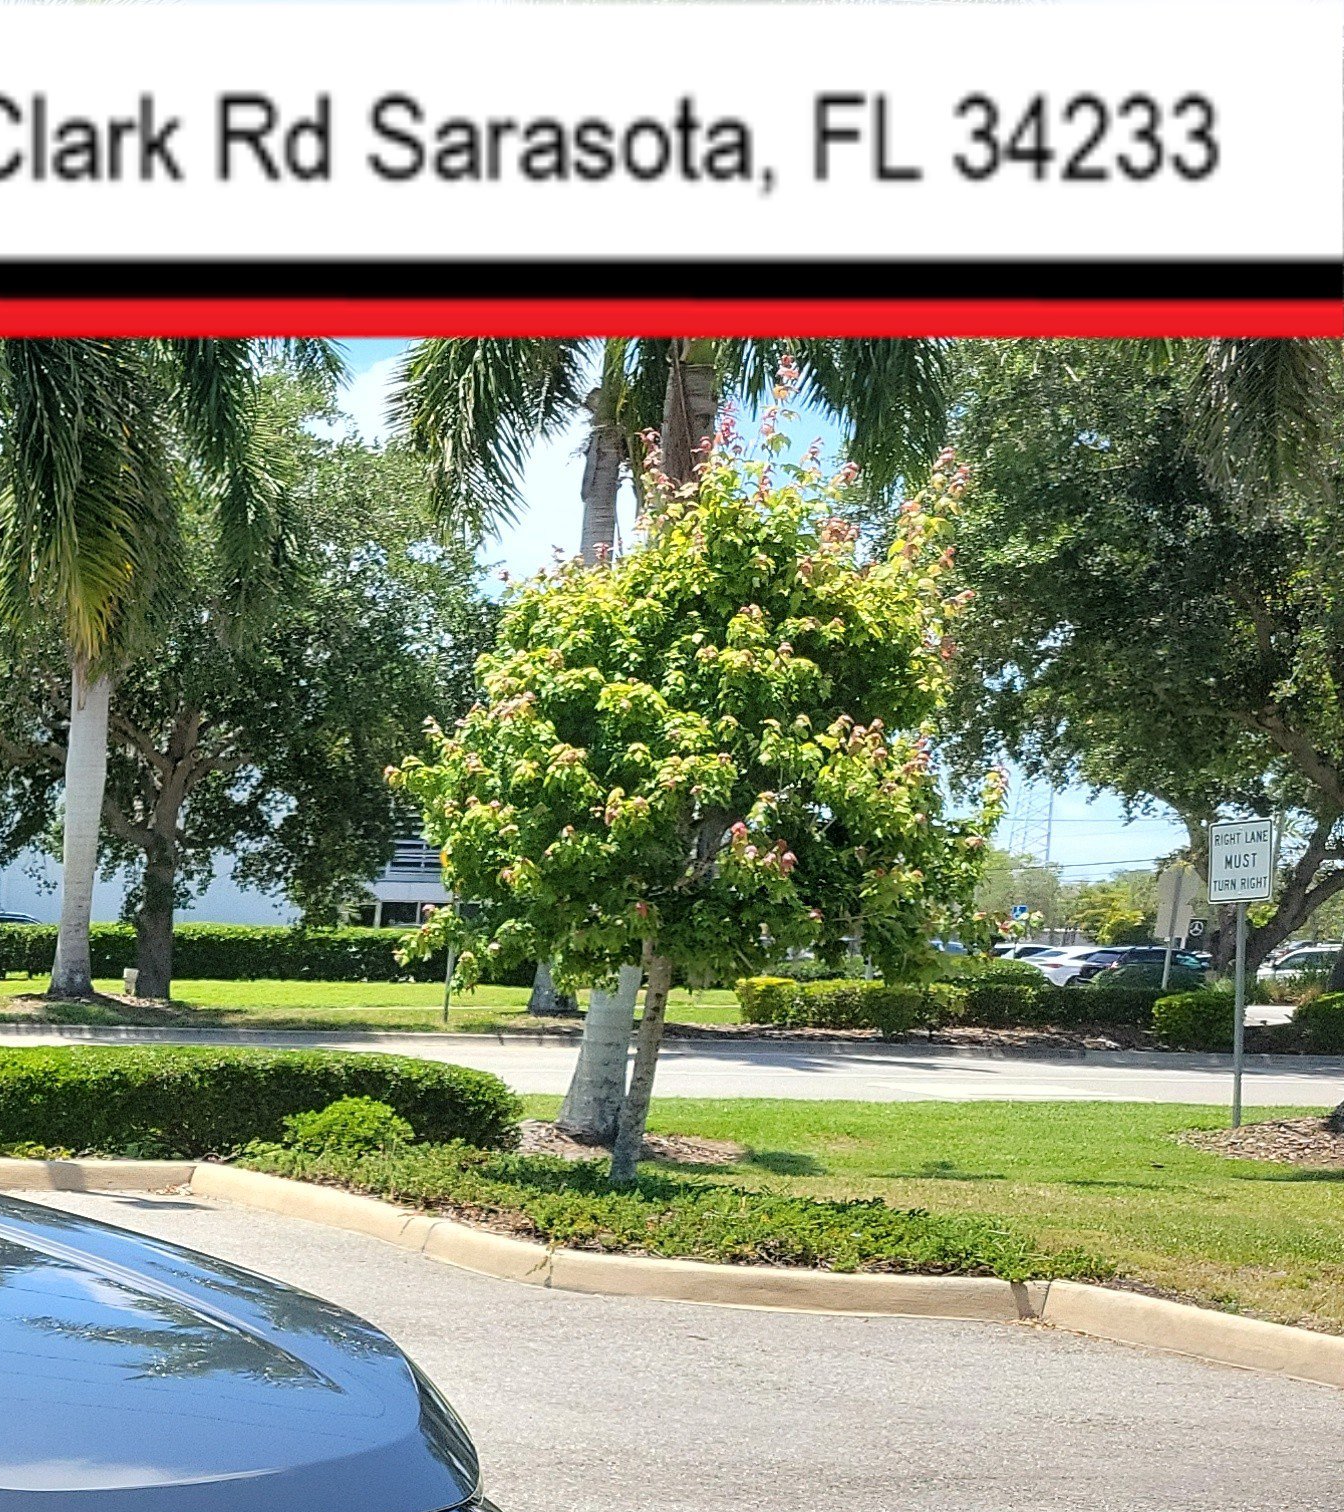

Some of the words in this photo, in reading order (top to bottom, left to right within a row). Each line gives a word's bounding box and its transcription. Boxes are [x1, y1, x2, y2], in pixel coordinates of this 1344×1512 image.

[1214, 832, 1242, 847] RIGHT
[1245, 829, 1269, 844] LANE
[1224, 852, 1258, 870] MUST
[1213, 878, 1237, 892] TURN
[1240, 876, 1268, 890] RIGHT
